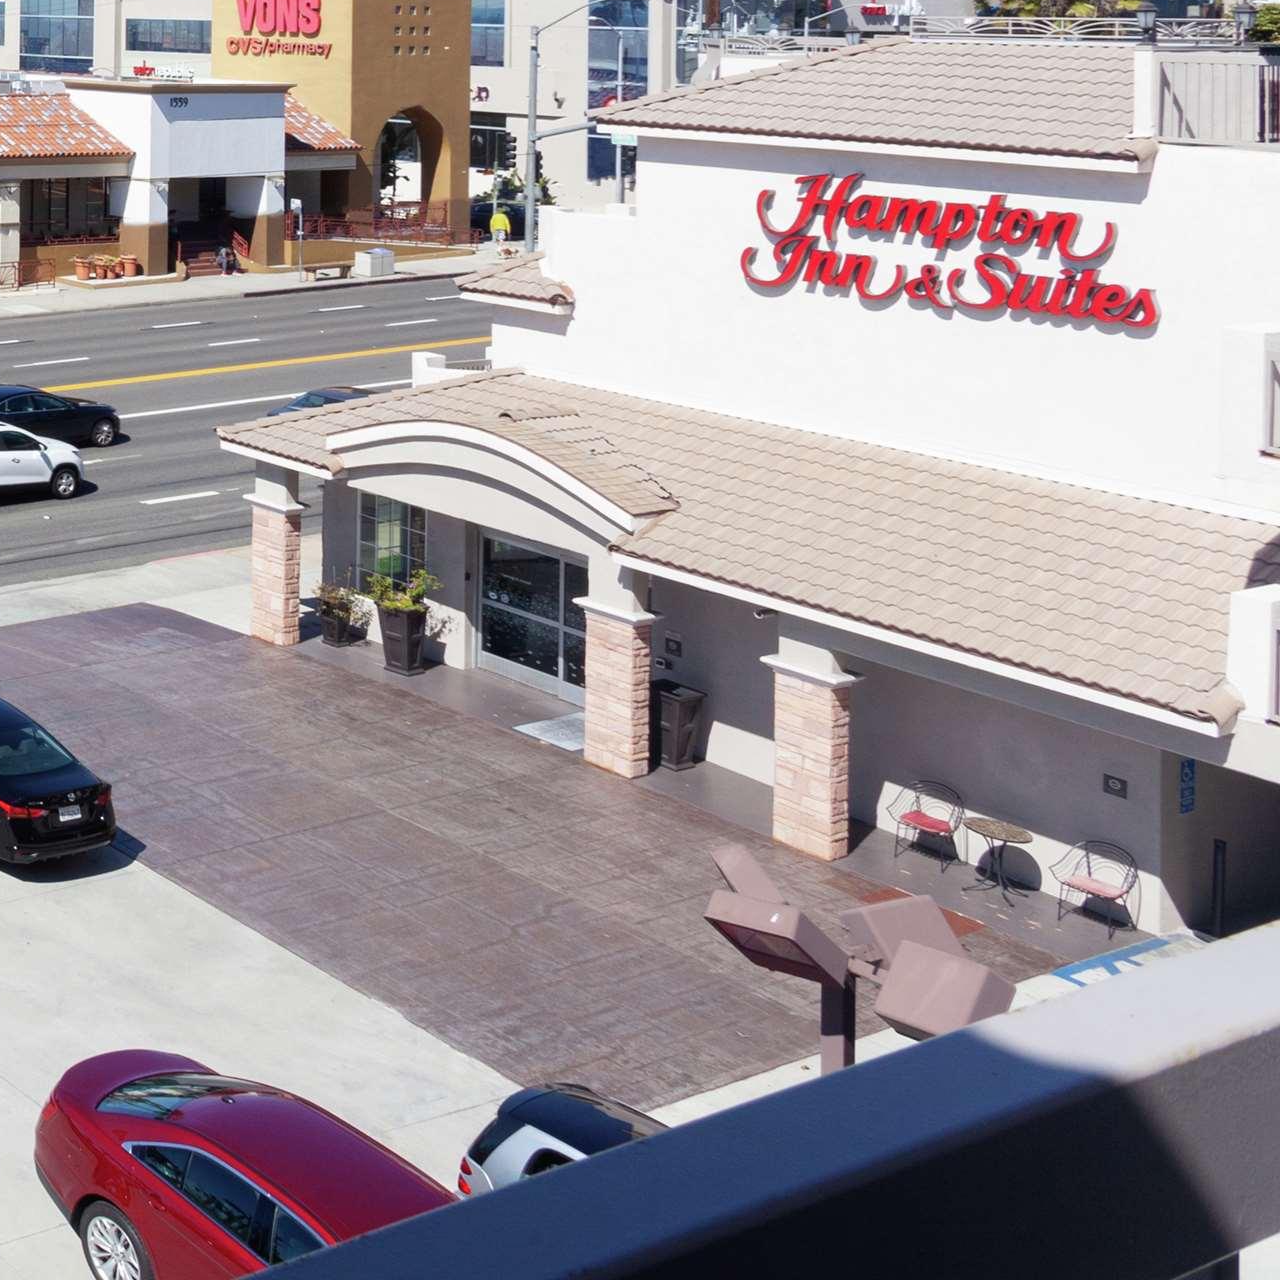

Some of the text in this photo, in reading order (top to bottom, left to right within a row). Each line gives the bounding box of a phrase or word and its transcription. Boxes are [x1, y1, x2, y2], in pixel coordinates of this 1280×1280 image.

[226, 36, 333, 60] CVS/pharmacy
[169, 96, 190, 109] 1559
[756, 172, 1118, 262] Hampton
[741, 235, 1160, 328] Inn & Suites
